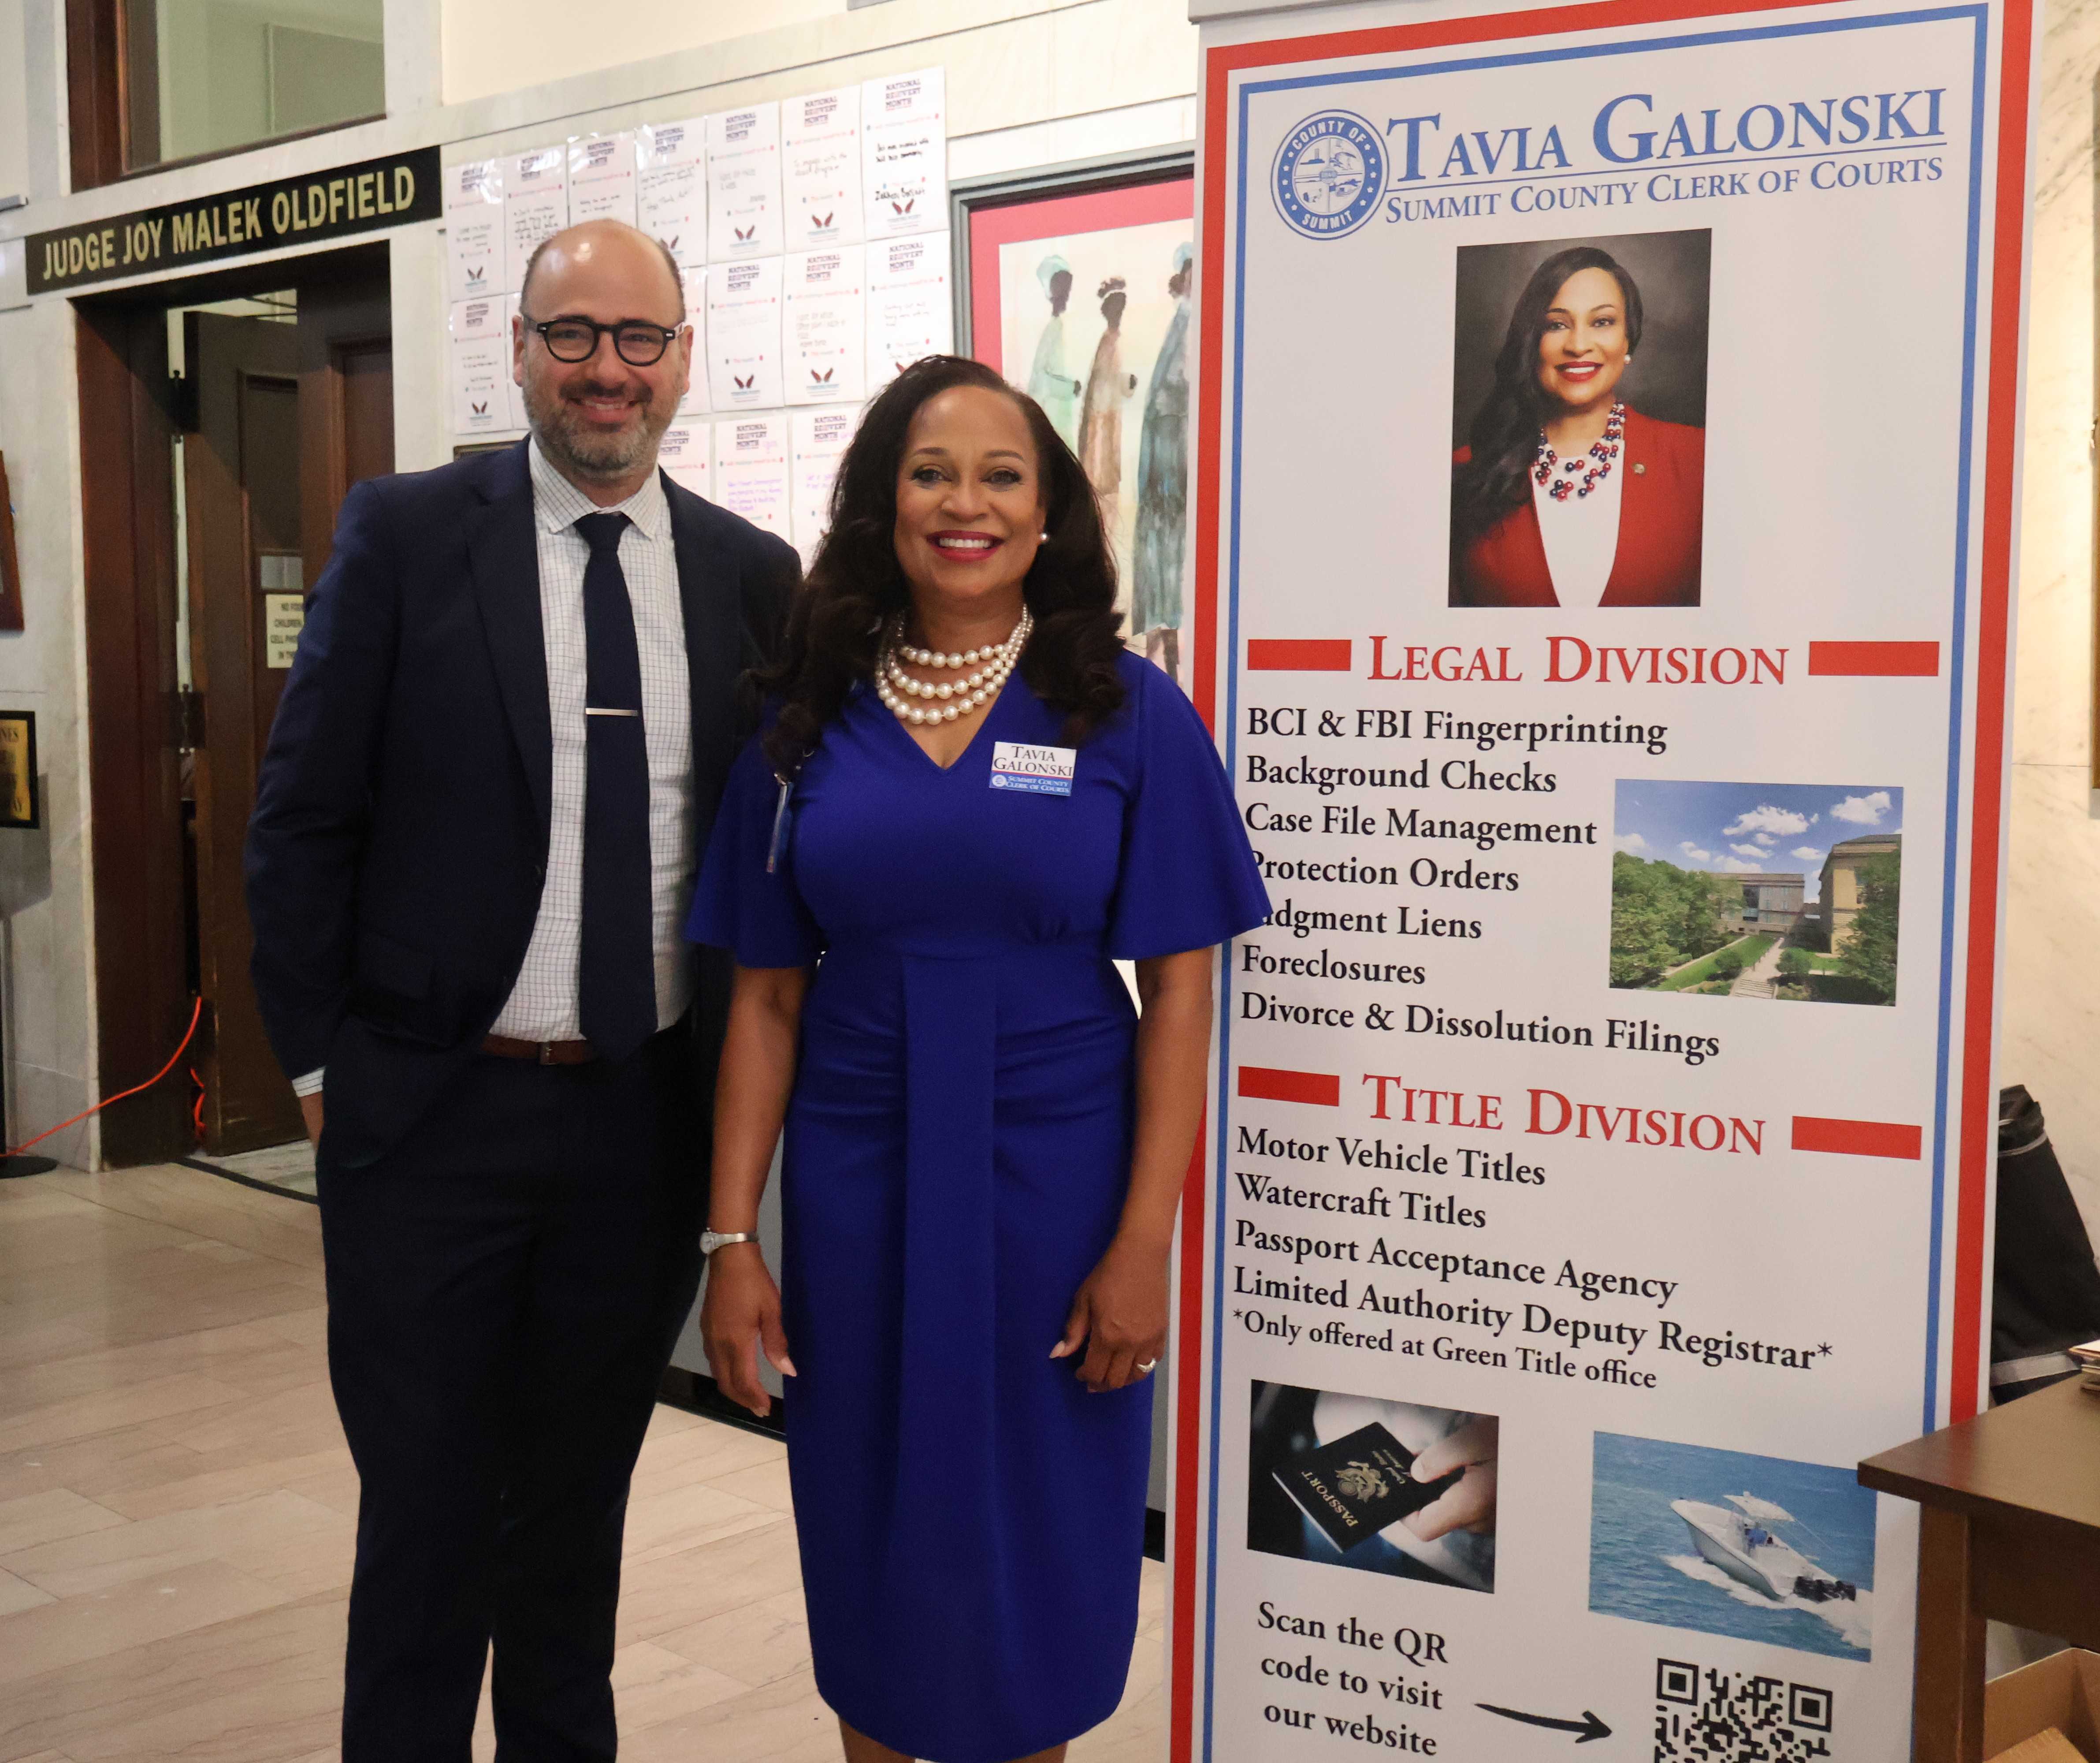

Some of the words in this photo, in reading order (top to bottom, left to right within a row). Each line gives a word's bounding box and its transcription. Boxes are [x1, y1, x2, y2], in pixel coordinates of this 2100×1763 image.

[1292, 120, 1345, 150] COUNTY
[1348, 127, 1367, 143] OF
[1386, 112, 1572, 182] TAVIA
[1592, 88, 1947, 163] GALONSKI
[1386, 193, 1502, 223] SUMMIT
[1510, 182, 1639, 213] COUNTY
[1647, 172, 1750, 203] CLERK
[1758, 169, 1799, 194] OF
[1811, 157, 1943, 190] COURTS
[43, 229, 115, 279] JUDGE
[123, 219, 163, 264] JOY
[173, 198, 262, 253] MALEK
[272, 167, 414, 234] OLDFIELD
[1302, 210, 1353, 230] SUMMIT
[1368, 636, 1521, 681] LEGAL
[1545, 636, 1788, 684] DIVISION
[1011, 746, 1056, 762] TAVIA
[1247, 708, 1307, 736] BCI
[1319, 710, 1345, 737] &
[1356, 710, 1412, 738] FBI
[1424, 711, 1667, 755] Fingerprinting
[994, 757, 1073, 776] GALONSKI
[1246, 755, 1429, 795] Background
[1442, 760, 1555, 792] Checks
[1246, 803, 1312, 832] Case
[1322, 806, 1375, 835] File
[1386, 808, 1597, 850] Management
[1410, 857, 1519, 892] Orders
[1263, 898, 1387, 938] dgment
[1397, 906, 1482, 939] Liens
[1242, 945, 1424, 984] Foreclosures
[1241, 992, 1353, 1027] Divorce
[1365, 1004, 1394, 1030] &
[1405, 1005, 1593, 1046] Dissolution
[1606, 1019, 1718, 1065] Filings
[1363, 1075, 1502, 1130] TITLE
[1526, 1089, 1765, 1155] DIVISION
[1237, 1126, 1329, 1162] Motor
[1336, 1137, 1447, 1175] Vehicle
[1457, 1149, 1545, 1185] Titles
[1235, 1173, 1390, 1217] Watercraft
[1399, 1191, 1485, 1227] Titles
[1235, 1220, 1359, 1265] Passport
[1367, 1238, 1544, 1283] Acceptance
[1554, 1260, 1678, 1308] Agency
[1234, 1266, 1349, 1308] Limited
[1357, 1284, 1513, 1337] Authority
[1522, 1304, 1648, 1356] Deputy
[1309, 1322, 1393, 1351] offered
[1402, 1340, 1424, 1356] at
[1433, 1337, 1507, 1367] Green
[1516, 1347, 1576, 1376] Title
[1585, 1359, 1656, 1388] office
[1301, 1471, 1358, 1527] PASSPORT
[1258, 1602, 1326, 1639] Scan
[1337, 1617, 1383, 1650] the
[1394, 1629, 1448, 1667] QR
[1261, 1655, 1328, 1685] code
[1339, 1670, 1368, 1693] to
[1378, 1676, 1442, 1710] visit
[1264, 1705, 1316, 1730] our
[1324, 1715, 1436, 1756] website
